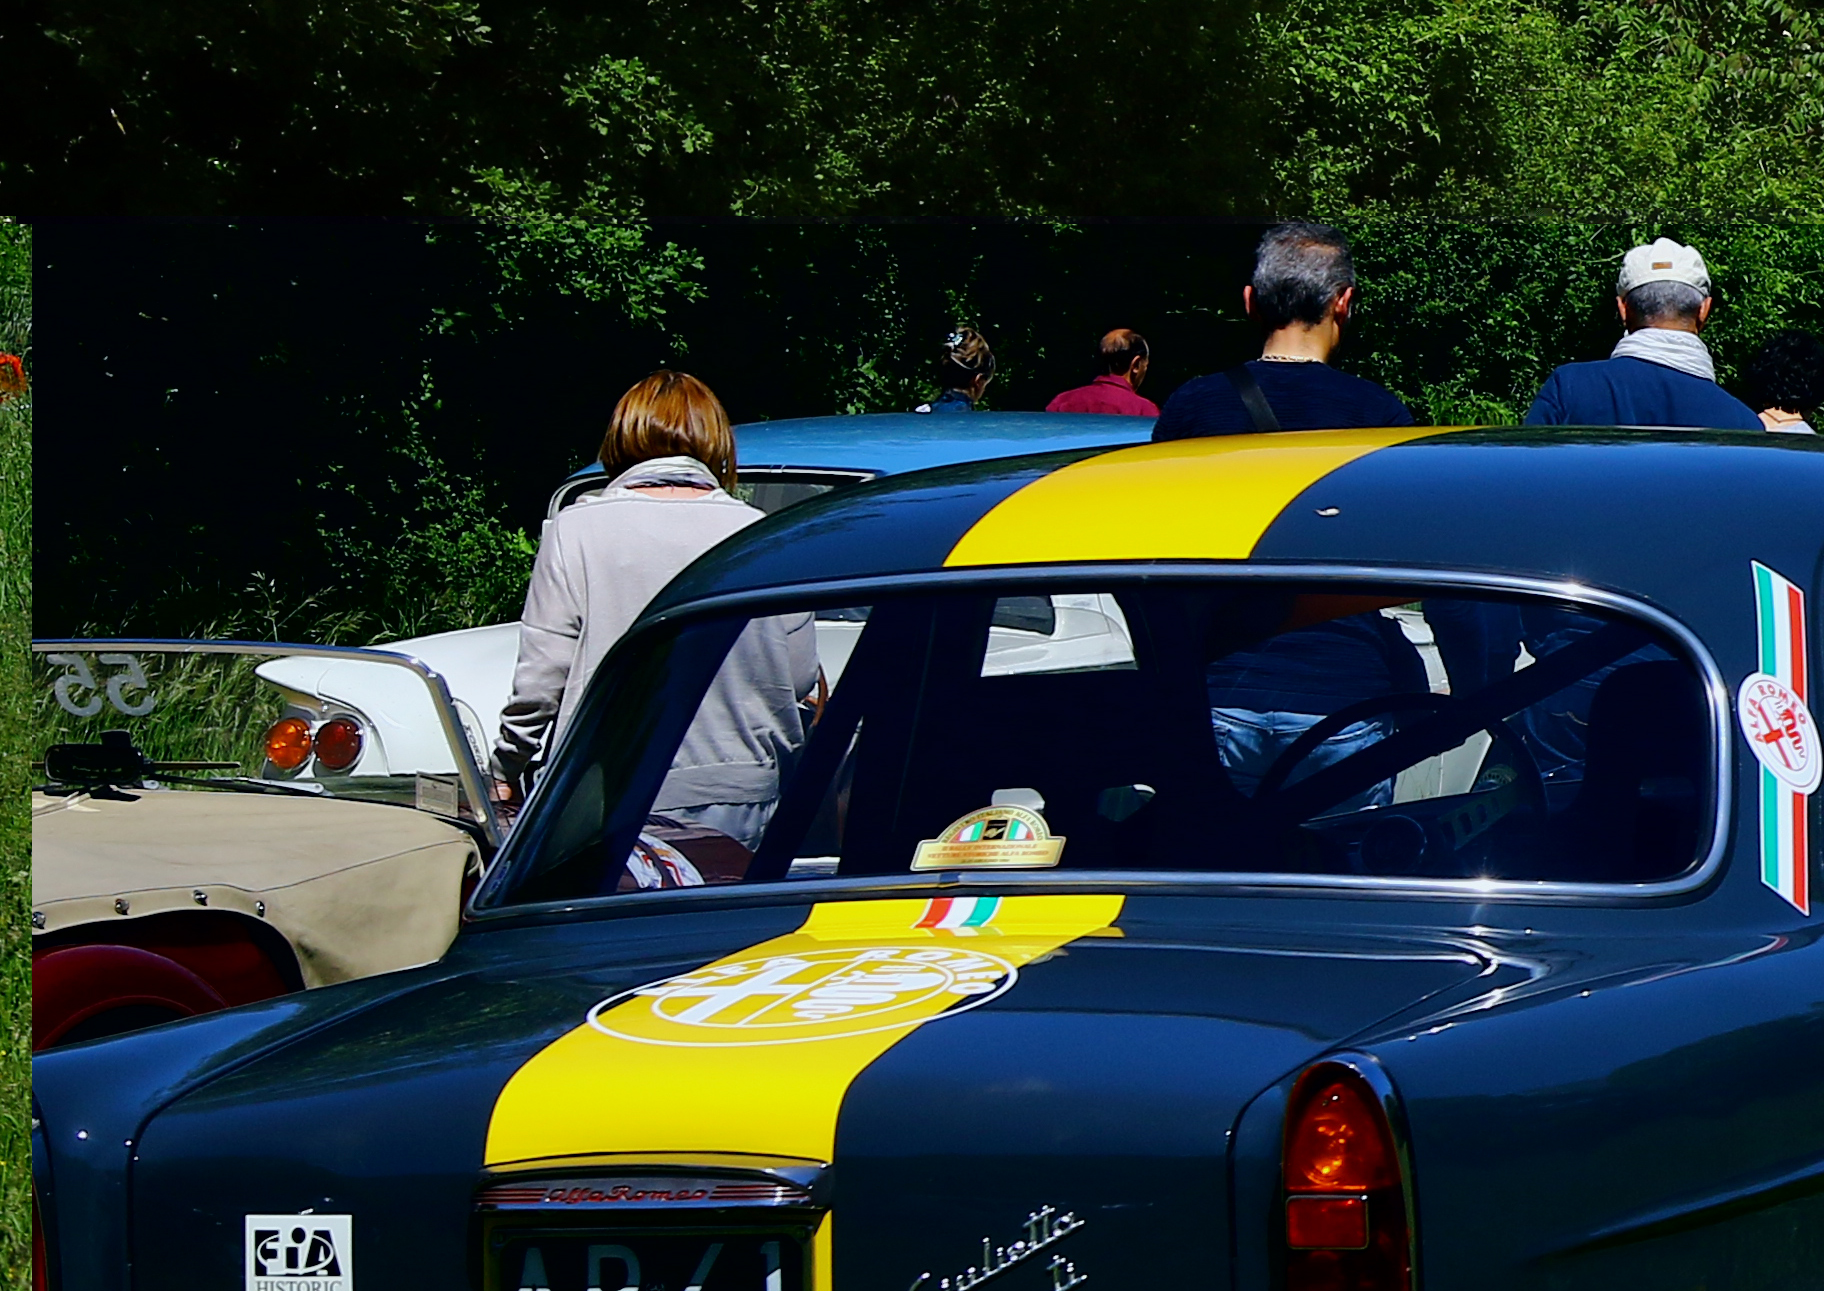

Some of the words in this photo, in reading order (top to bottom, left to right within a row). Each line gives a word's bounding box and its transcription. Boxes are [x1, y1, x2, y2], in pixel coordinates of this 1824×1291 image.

[1748, 697, 1766, 743] ALFA
[1757, 683, 1807, 725] ROMEO
[854, 948, 1004, 996] ROMEO
